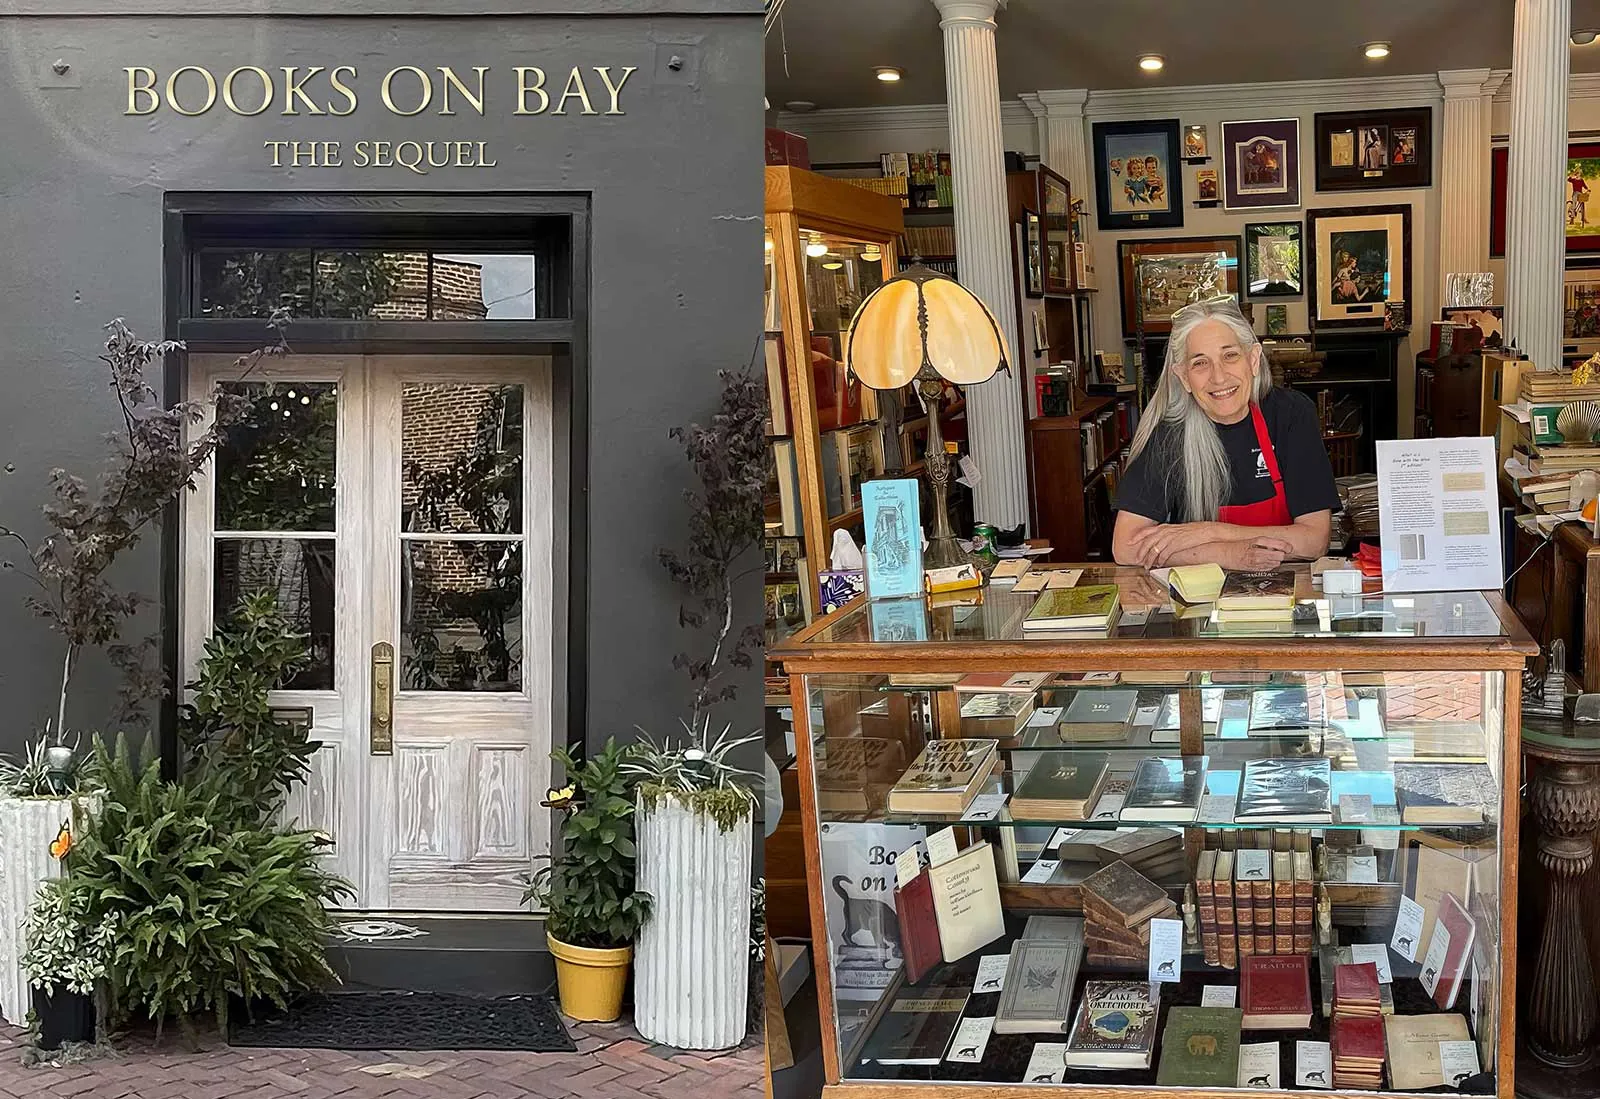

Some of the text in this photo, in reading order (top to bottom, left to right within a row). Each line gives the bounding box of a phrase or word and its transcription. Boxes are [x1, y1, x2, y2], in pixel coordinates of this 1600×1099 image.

[123, 65, 638, 117] BOOKS ON BAY
[264, 140, 498, 175] THE SEQUEL
[921, 762, 975, 772] WIND
[861, 876, 888, 891] on
[1109, 993, 1132, 1001] LAKE
[1090, 1001, 1147, 1010] OKEECHOBEE
